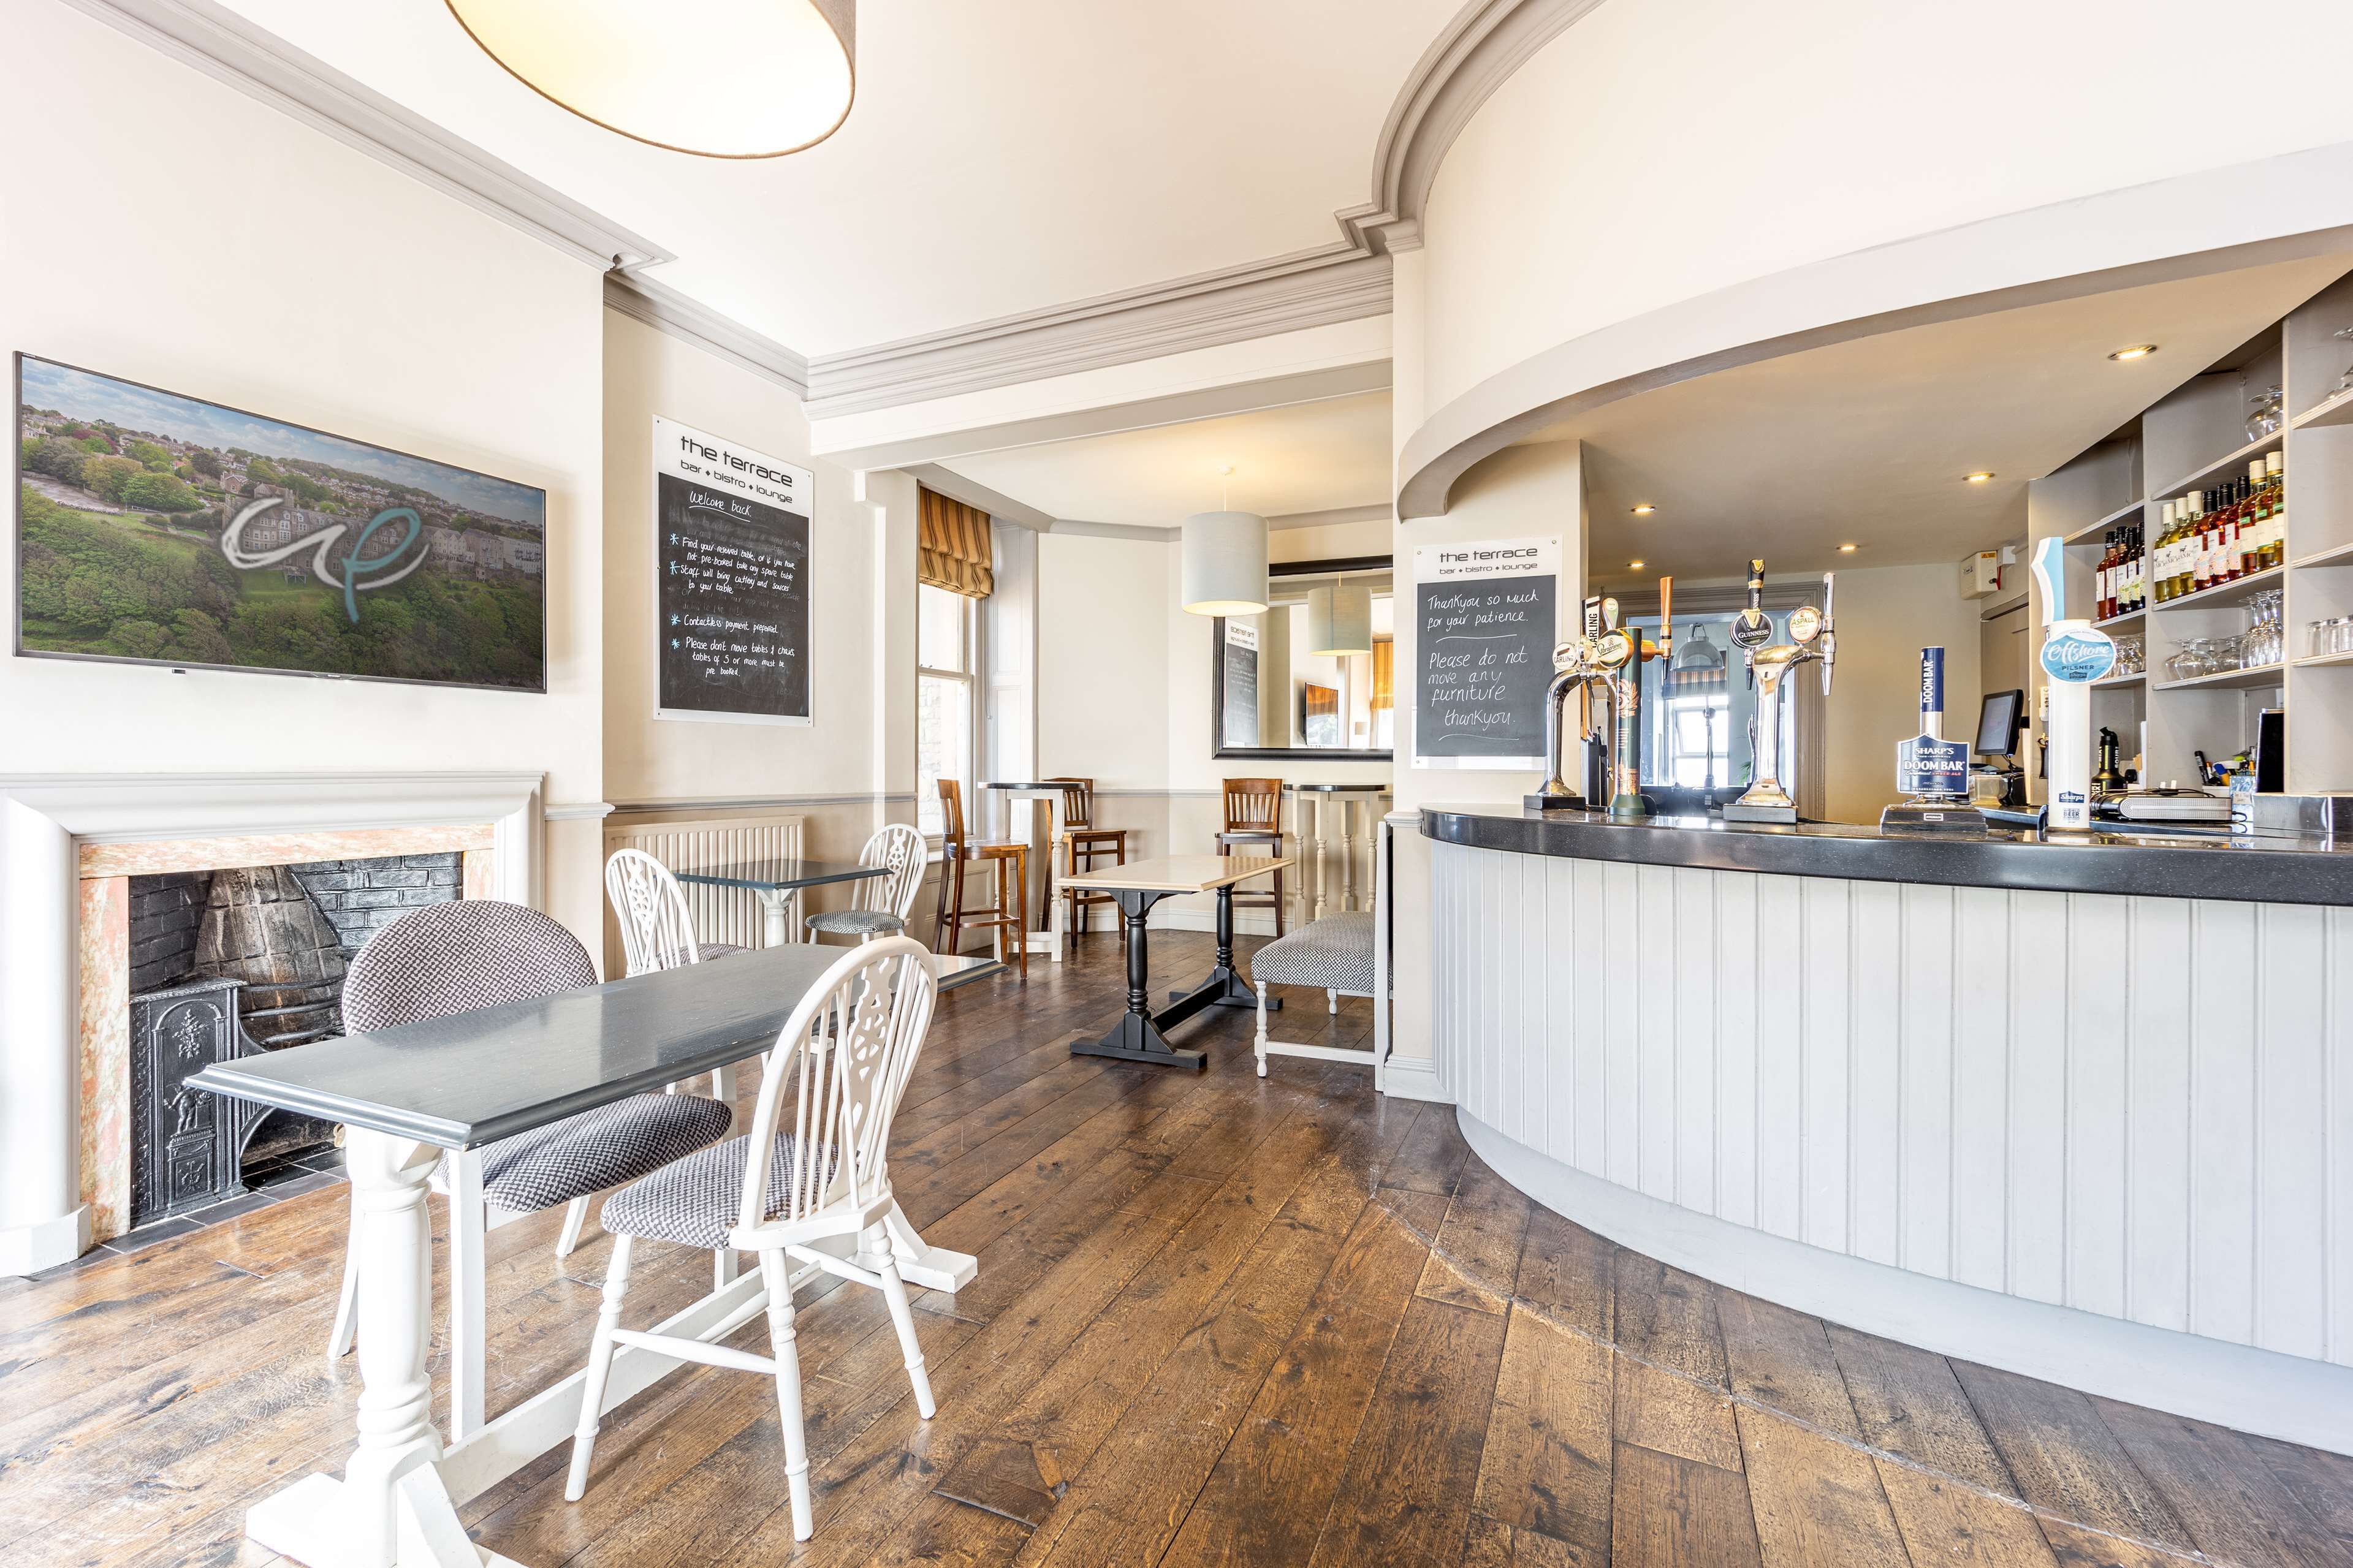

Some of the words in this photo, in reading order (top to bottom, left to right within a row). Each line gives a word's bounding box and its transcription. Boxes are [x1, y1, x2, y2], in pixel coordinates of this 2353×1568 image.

[681, 436, 717, 461] the
[723, 451, 792, 487] terrace
[681, 460, 701, 473] bar
[714, 470, 746, 488] bistro
[757, 485, 792, 503] lounge
[683, 537, 698, 549] Find
[701, 544, 714, 552] your
[774, 559, 782, 567] you
[1440, 552, 1468, 563] the
[1473, 548, 1537, 560] terrace
[681, 565, 699, 578] Staff
[703, 569, 712, 578] will
[717, 570, 730, 583] bring
[757, 579, 767, 588] and
[750, 565, 759, 576] any
[761, 569, 777, 578] spare
[700, 583, 712, 594] your
[1487, 595, 1500, 605] so
[1507, 589, 1539, 604] much
[684, 614, 722, 627] Contactless
[726, 620, 749, 632] payment
[1427, 617, 1442, 632] for
[1447, 614, 1469, 632] your
[1475, 611, 1528, 626] patience.
[1792, 617, 1815, 625] ASPALL
[1589, 613, 1597, 648] CARLING
[1738, 629, 1769, 639] GUINNESS
[686, 636, 707, 650] Please
[731, 644, 747, 653] move
[751, 644, 768, 654] tables
[2048, 641, 2109, 664] Offshore
[692, 651, 711, 662] tables
[714, 655, 720, 664] of
[762, 659, 775, 667] must
[1430, 652, 1470, 669] Please
[1479, 648, 1496, 665] do
[1505, 645, 1528, 663] not
[706, 667, 715, 677] pre
[1923, 660, 1934, 675] BAR
[1428, 672, 1457, 684] move
[1469, 671, 1501, 686] any
[1432, 684, 1505, 707] furniture
[1923, 676, 1933, 703] DOOM
[1904, 761, 1938, 770] DOOM
[1941, 761, 1964, 770] BAR
